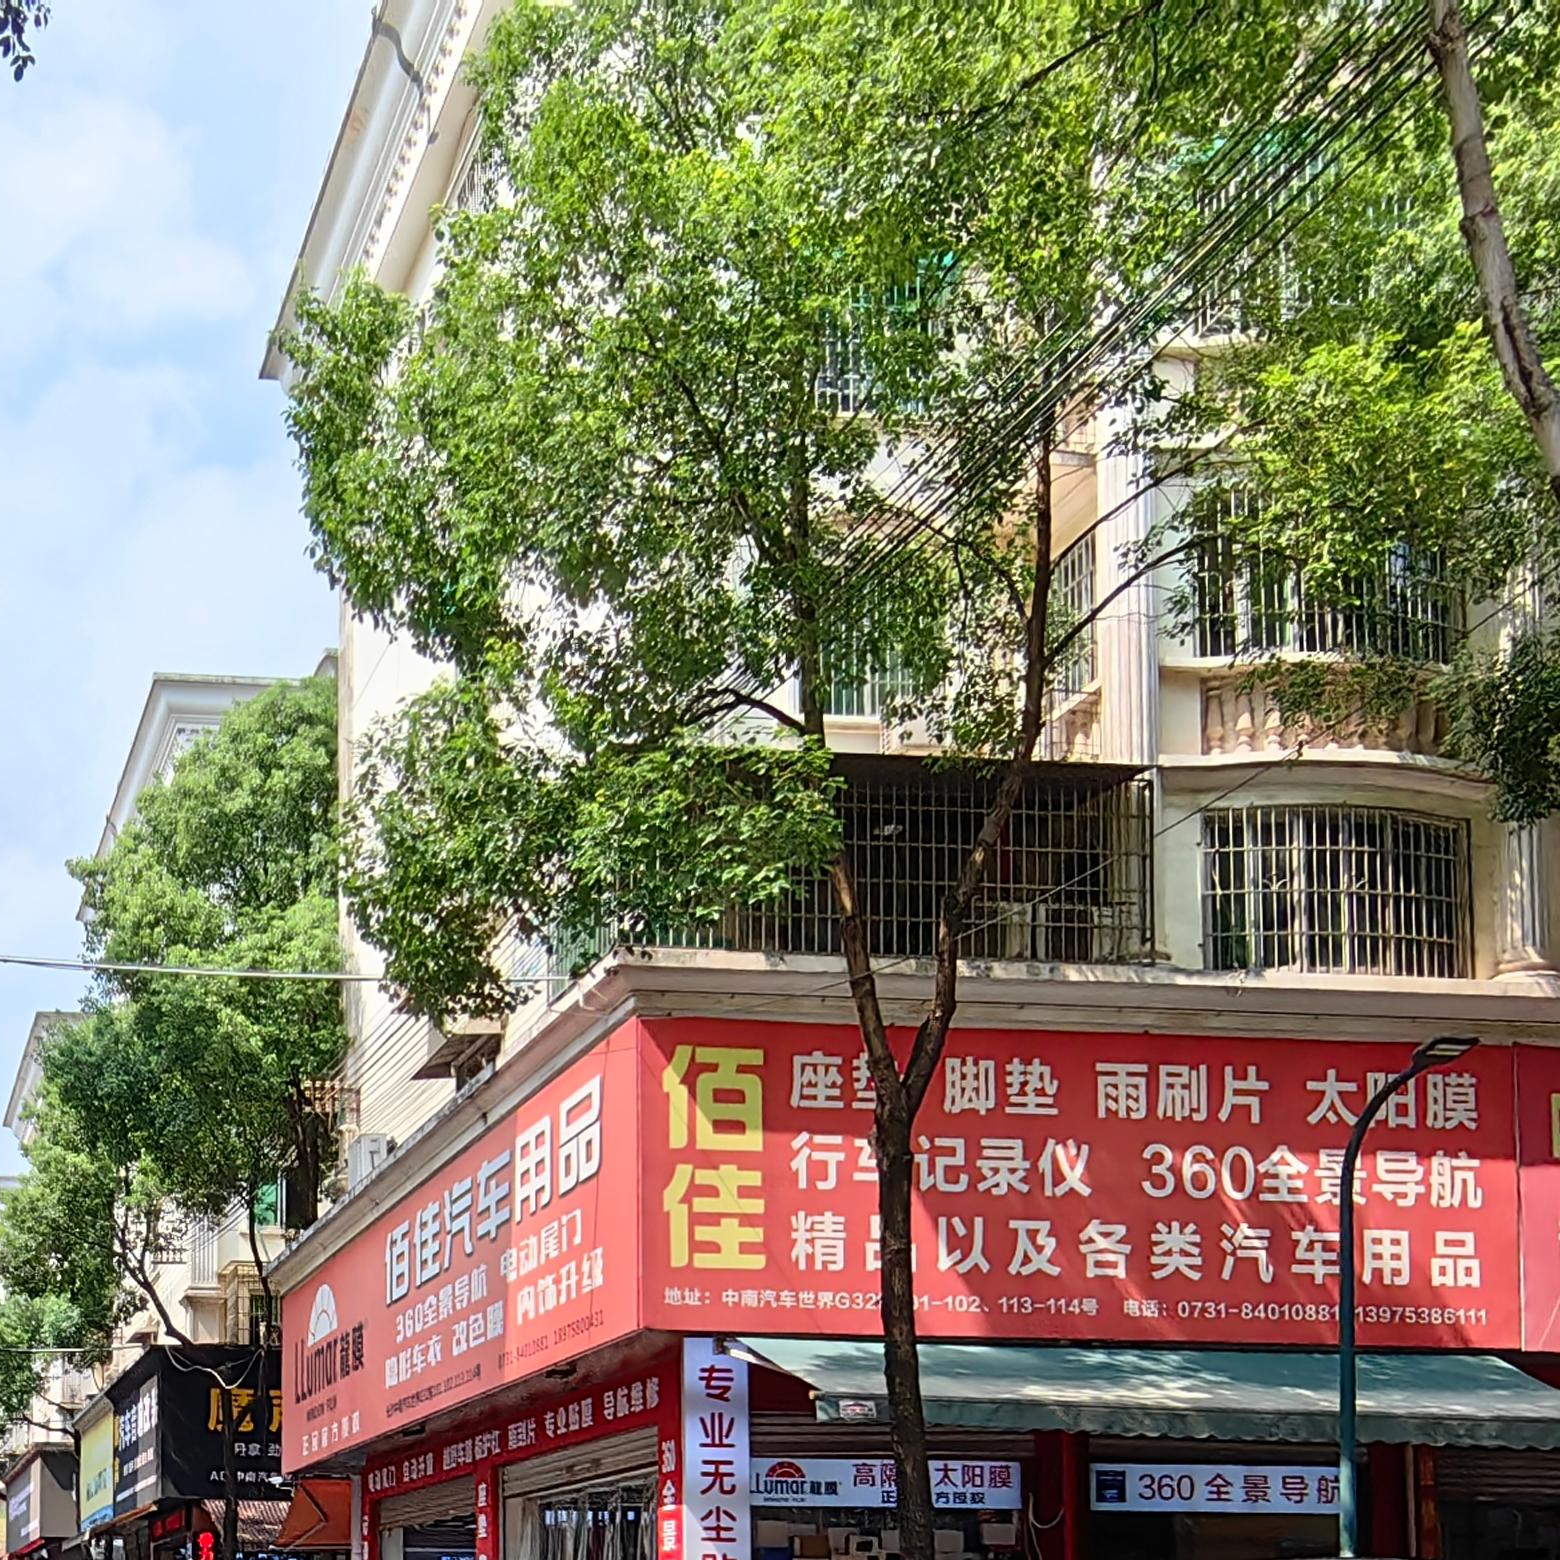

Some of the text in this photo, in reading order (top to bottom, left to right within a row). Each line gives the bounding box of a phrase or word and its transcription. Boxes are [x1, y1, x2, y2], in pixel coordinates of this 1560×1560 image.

[943, 1056, 1060, 1116] 脚垫
[1095, 1062, 1270, 1125] 雨刷片
[1306, 1069, 1479, 1131] 太阳膜
[384, 1074, 602, 1304] 佰佳汽车用品
[662, 1045, 767, 1270] 佰佳
[1141, 1144, 1483, 1208] 360全景导航
[396, 1208, 582, 1344] 360全景导航 电动尾门
[516, 1246, 604, 1325] 内饰升级
[1355, 1306, 1487, 1326] 13975386111
